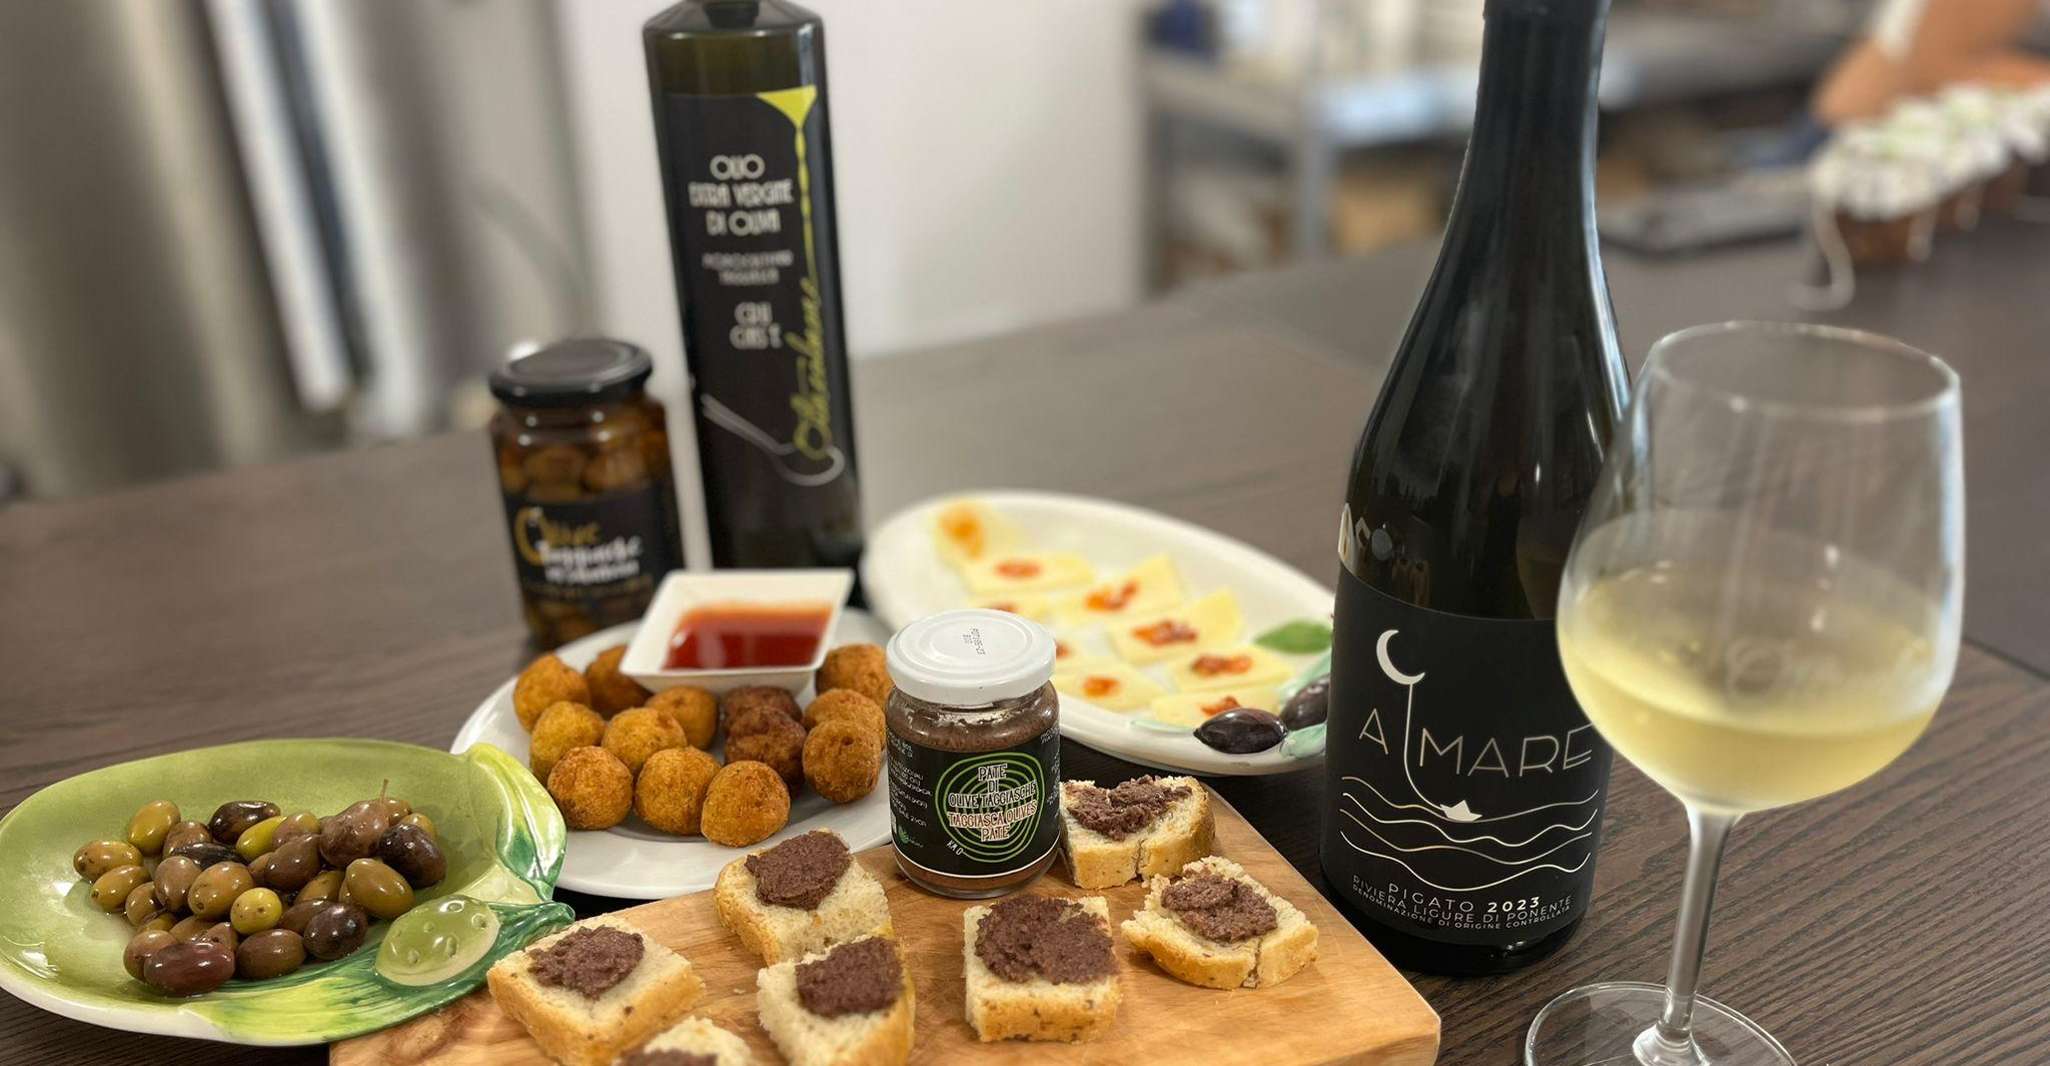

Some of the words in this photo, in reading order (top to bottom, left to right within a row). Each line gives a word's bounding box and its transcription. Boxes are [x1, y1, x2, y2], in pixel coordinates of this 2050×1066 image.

[948, 793, 979, 808] OLIVE
[980, 779, 1037, 808] TAGGIASCHE
[988, 780, 999, 792] DI
[947, 811, 1004, 828] TAGGIASCA
[1005, 799, 1038, 824] OLIVES
[1352, 875, 1407, 908] RIVIERA
[1413, 904, 1475, 923] LIGURE
[1483, 914, 1499, 923] DI
[1507, 895, 1572, 922] PONENTE
[1352, 884, 1433, 924] DENOMINAZIONE
[1438, 919, 1450, 927] DI
[1455, 922, 1500, 930] ORIGINE
[1506, 905, 1571, 929] CONTROLLATA
[1388, 883, 1474, 913] PIGATO
[1487, 896, 1541, 913] 2023
